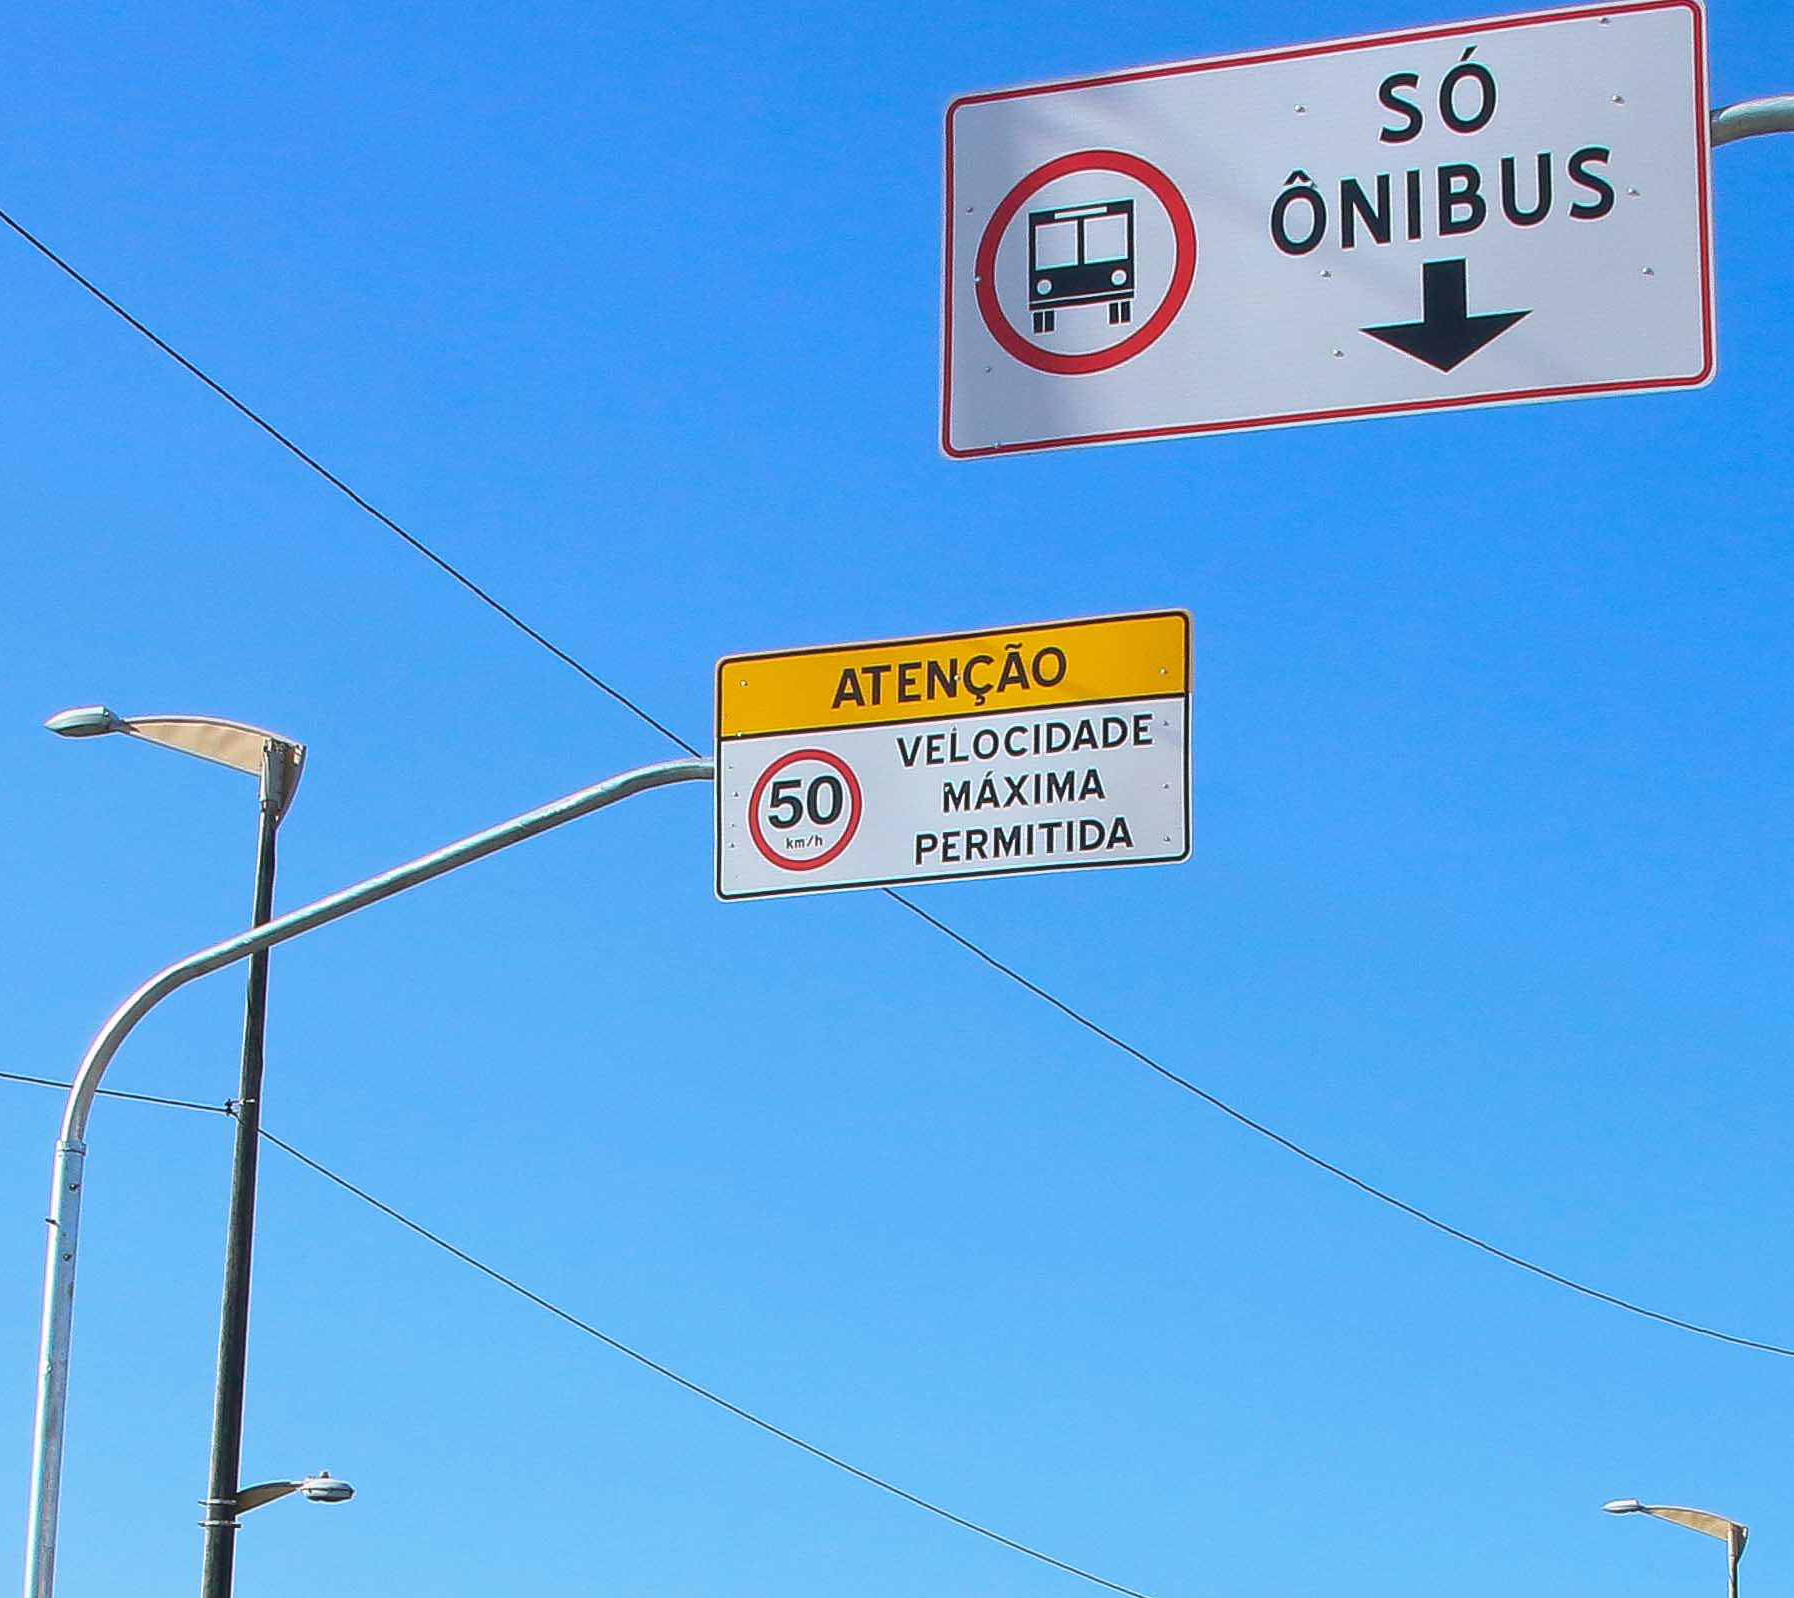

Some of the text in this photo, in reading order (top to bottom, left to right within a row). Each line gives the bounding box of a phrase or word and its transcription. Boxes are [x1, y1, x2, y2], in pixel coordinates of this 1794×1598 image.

[1377, 45, 1498, 144] SÓ
[1269, 145, 1616, 257] ÔNIBUS
[830, 642, 1068, 709] ATENÇÃO
[896, 713, 1154, 768] VELOCIDADE
[767, 775, 844, 830] 50
[941, 768, 1106, 814] MÁXIMA
[785, 834, 824, 851] km/h
[914, 816, 1135, 866] PERMITIDA
